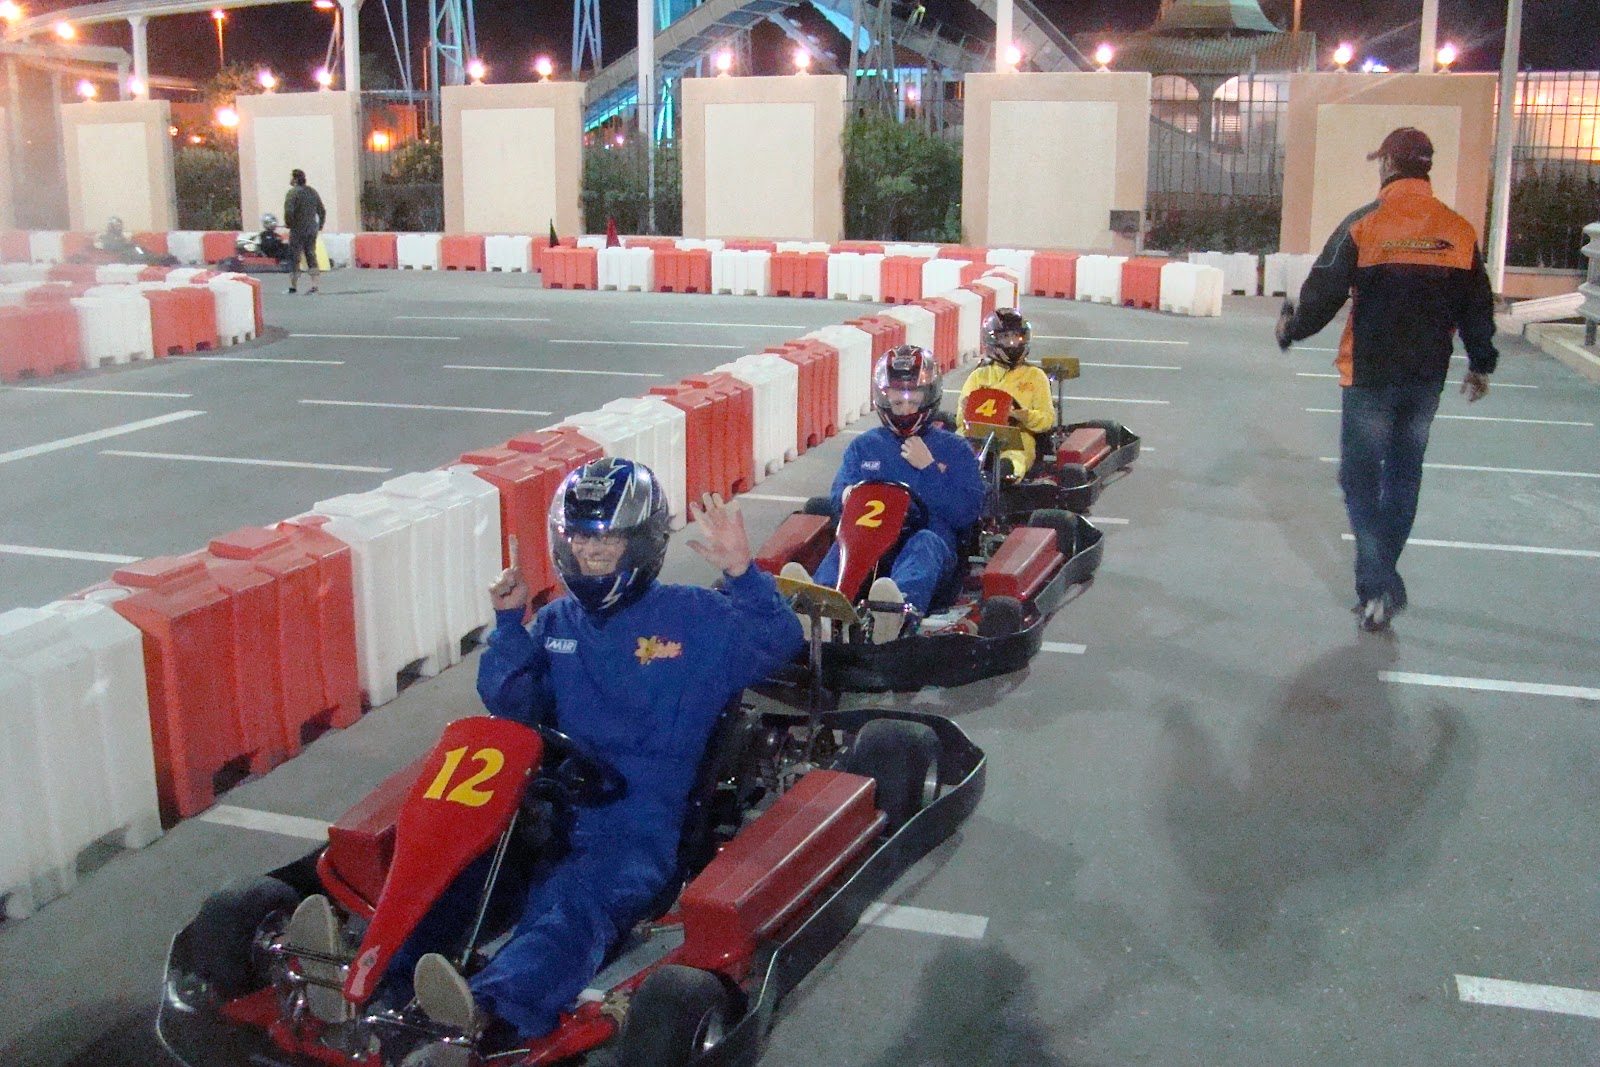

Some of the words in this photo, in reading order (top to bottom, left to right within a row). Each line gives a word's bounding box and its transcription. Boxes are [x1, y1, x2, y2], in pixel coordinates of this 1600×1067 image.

[975, 398, 998, 417] 4
[855, 500, 885, 528] 2
[547, 640, 575, 651] MIR
[423, 746, 505, 807] 12
